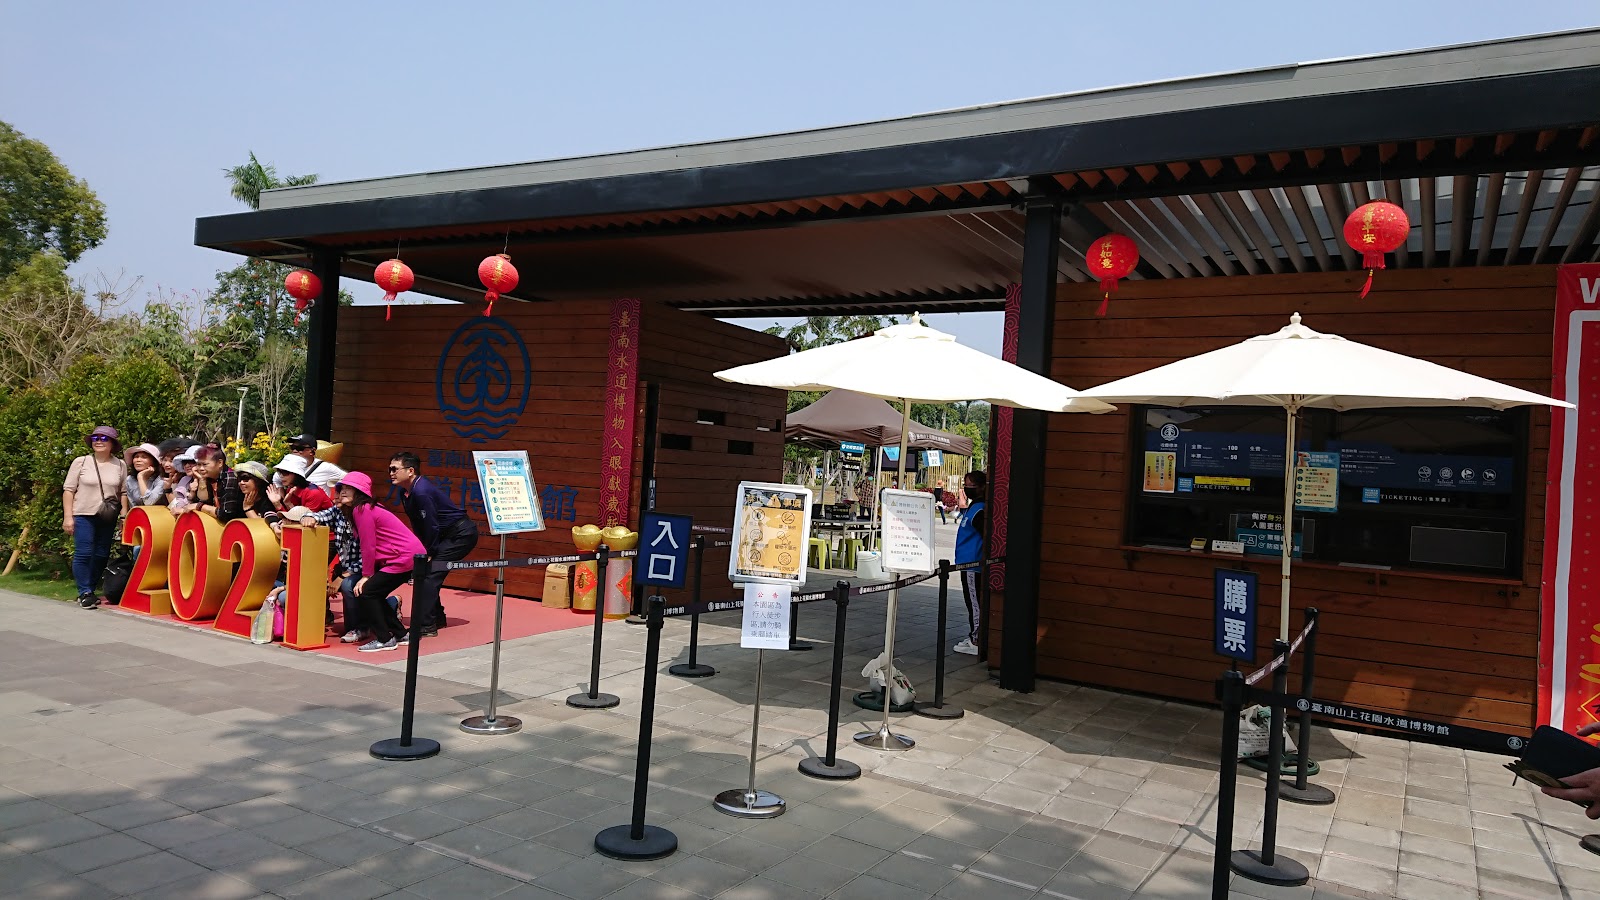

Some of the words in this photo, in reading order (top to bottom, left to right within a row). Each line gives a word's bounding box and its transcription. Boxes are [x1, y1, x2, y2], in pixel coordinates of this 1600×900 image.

[1380, 494, 1423, 502] TICKETING
[1251, 512, 1285, 522] 備好身分
[648, 520, 679, 581] 入口
[118, 505, 330, 650] 2021
[752, 610, 782, 620] 行人徒步
[753, 600, 782, 610] 本園區為
[1223, 578, 1248, 653] 購票
[1311, 702, 1450, 736] 臺南山上花園水道博物館
